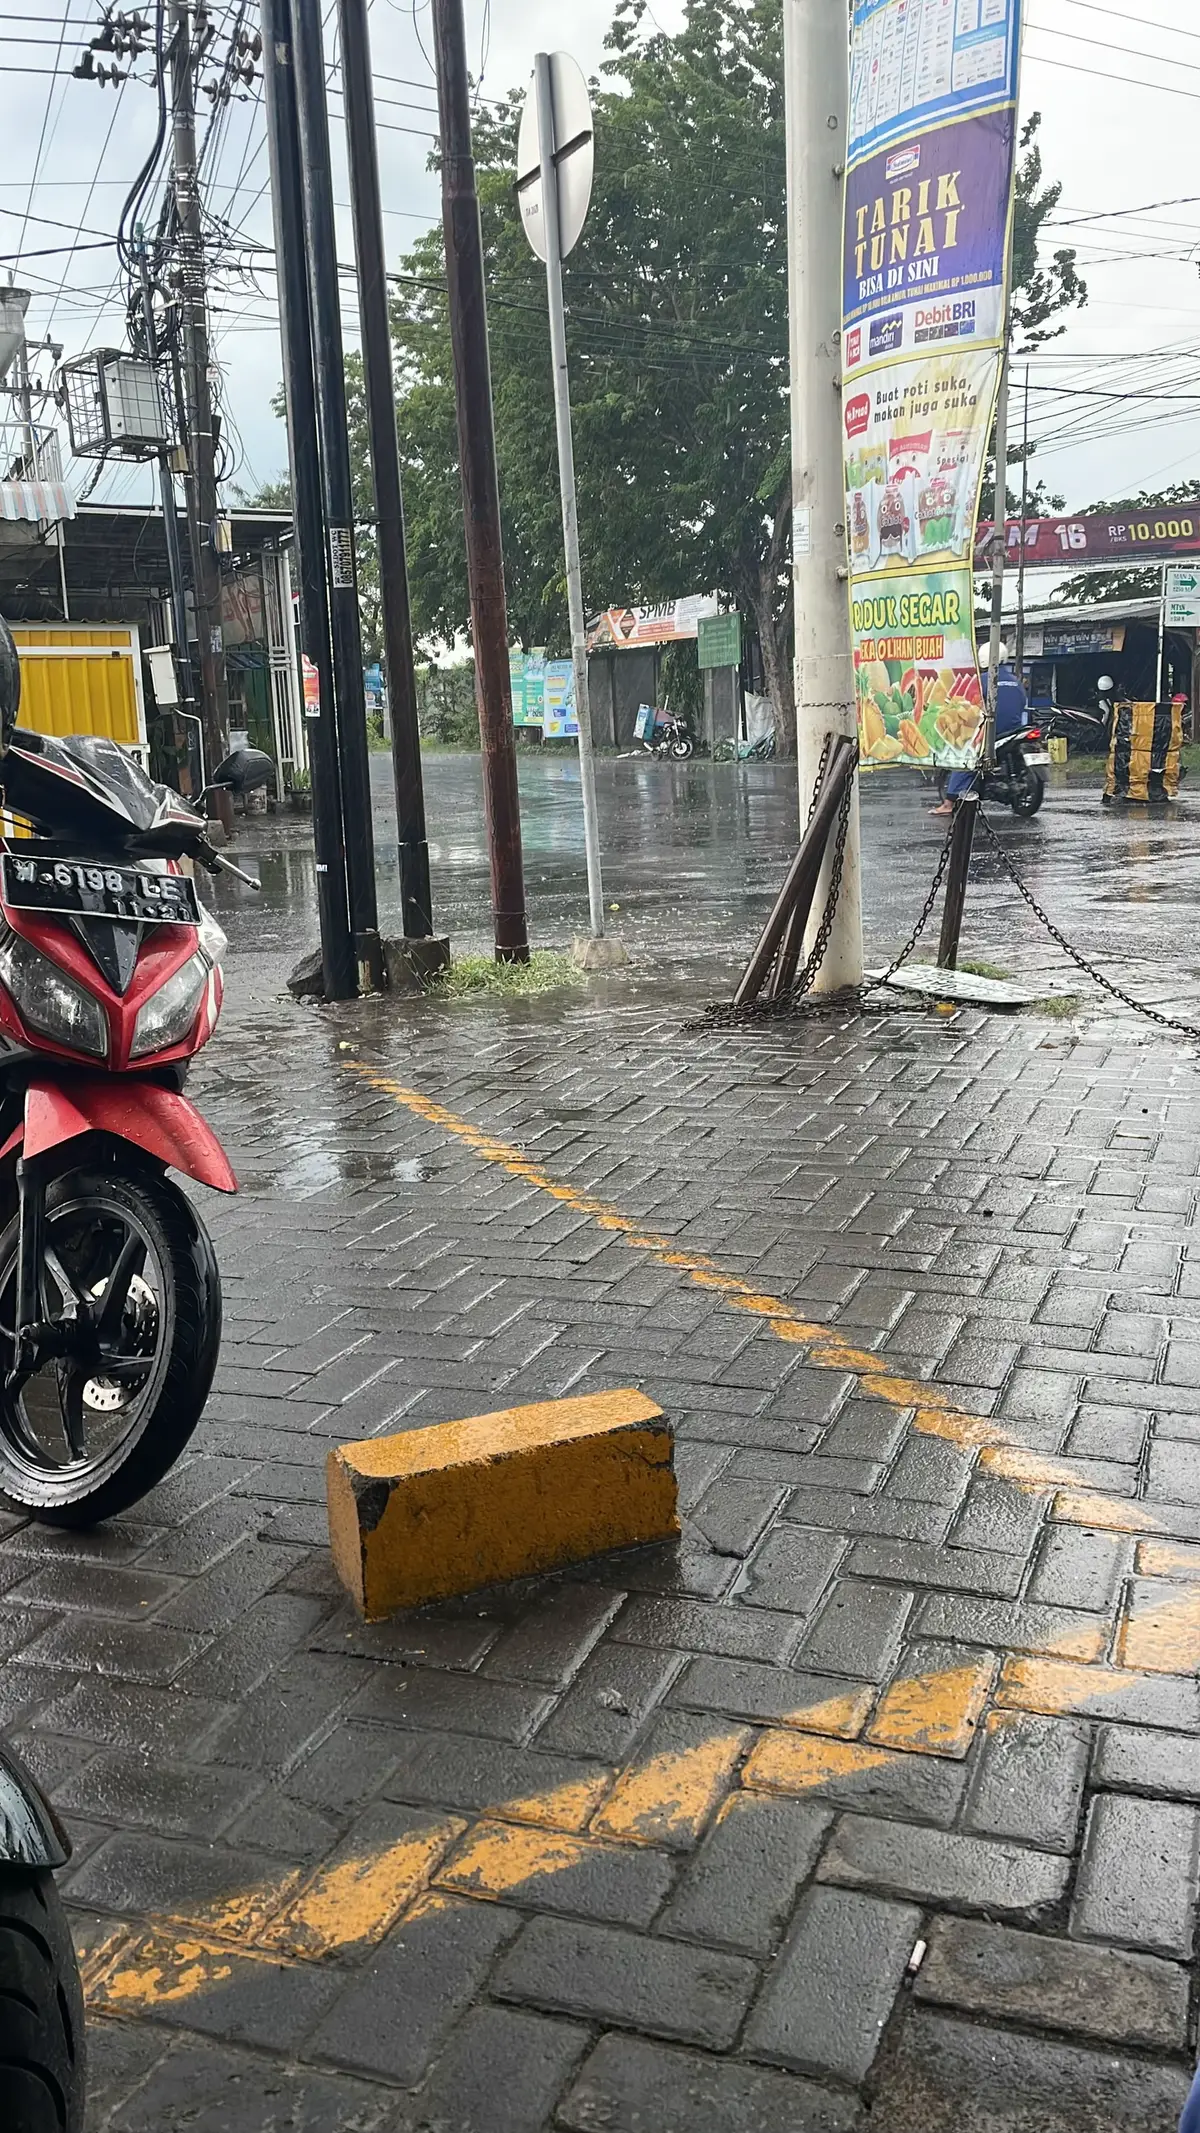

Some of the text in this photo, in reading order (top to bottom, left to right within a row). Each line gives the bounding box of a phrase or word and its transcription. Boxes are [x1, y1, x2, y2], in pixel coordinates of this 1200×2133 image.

[856, 170, 961, 241] TARIK
[855, 209, 961, 279] TUNAI
[859, 256, 939, 300] BISA DI SINI
[876, 375, 972, 405] Buat roti suka,
[874, 392, 977, 423] makan juga suka
[937, 453, 969, 465] Spesial
[331, 530, 338, 543] WC
[1054, 523, 1087, 550] 16
[1108, 520, 1194, 541] RP 10.000
[639, 600, 677, 619] SPMB
[900, 590, 961, 628] SEGAR
[915, 635, 944, 660] BUAH
[54, 862, 123, 893] 6198
[138, 874, 181, 901] LE
